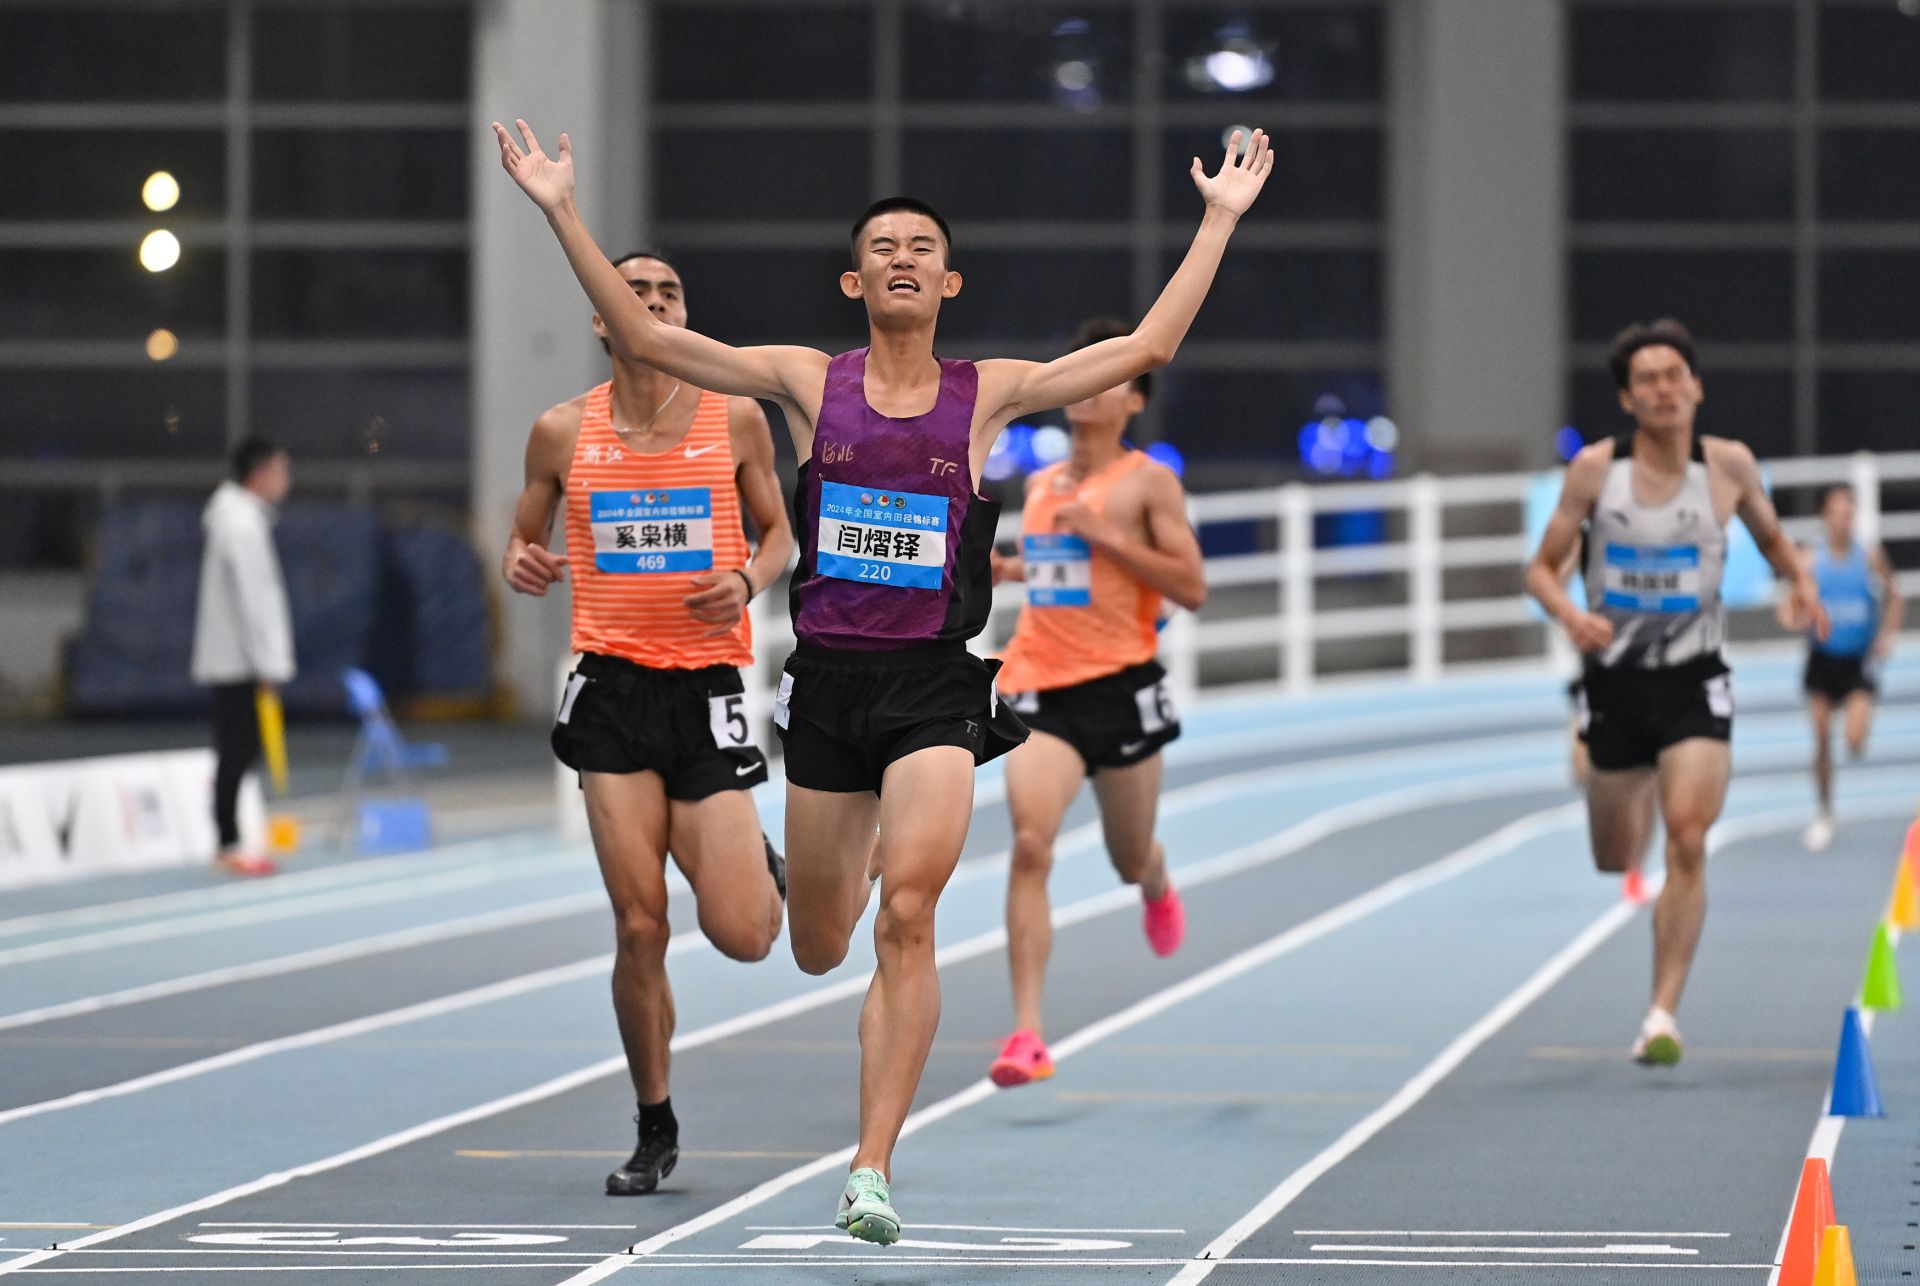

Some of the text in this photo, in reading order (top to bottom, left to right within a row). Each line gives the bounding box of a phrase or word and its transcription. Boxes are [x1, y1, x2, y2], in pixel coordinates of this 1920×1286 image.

[582, 446, 624, 464] 浙江
[929, 457, 959, 477] TF
[826, 503, 941, 527] 2024年全国室内田径锦标赛
[615, 522, 688, 548] 奚枭横
[837, 524, 921, 560] 闫熠铎
[636, 554, 667, 570] 469
[857, 563, 892, 581] 220
[724, 695, 749, 745] 5
